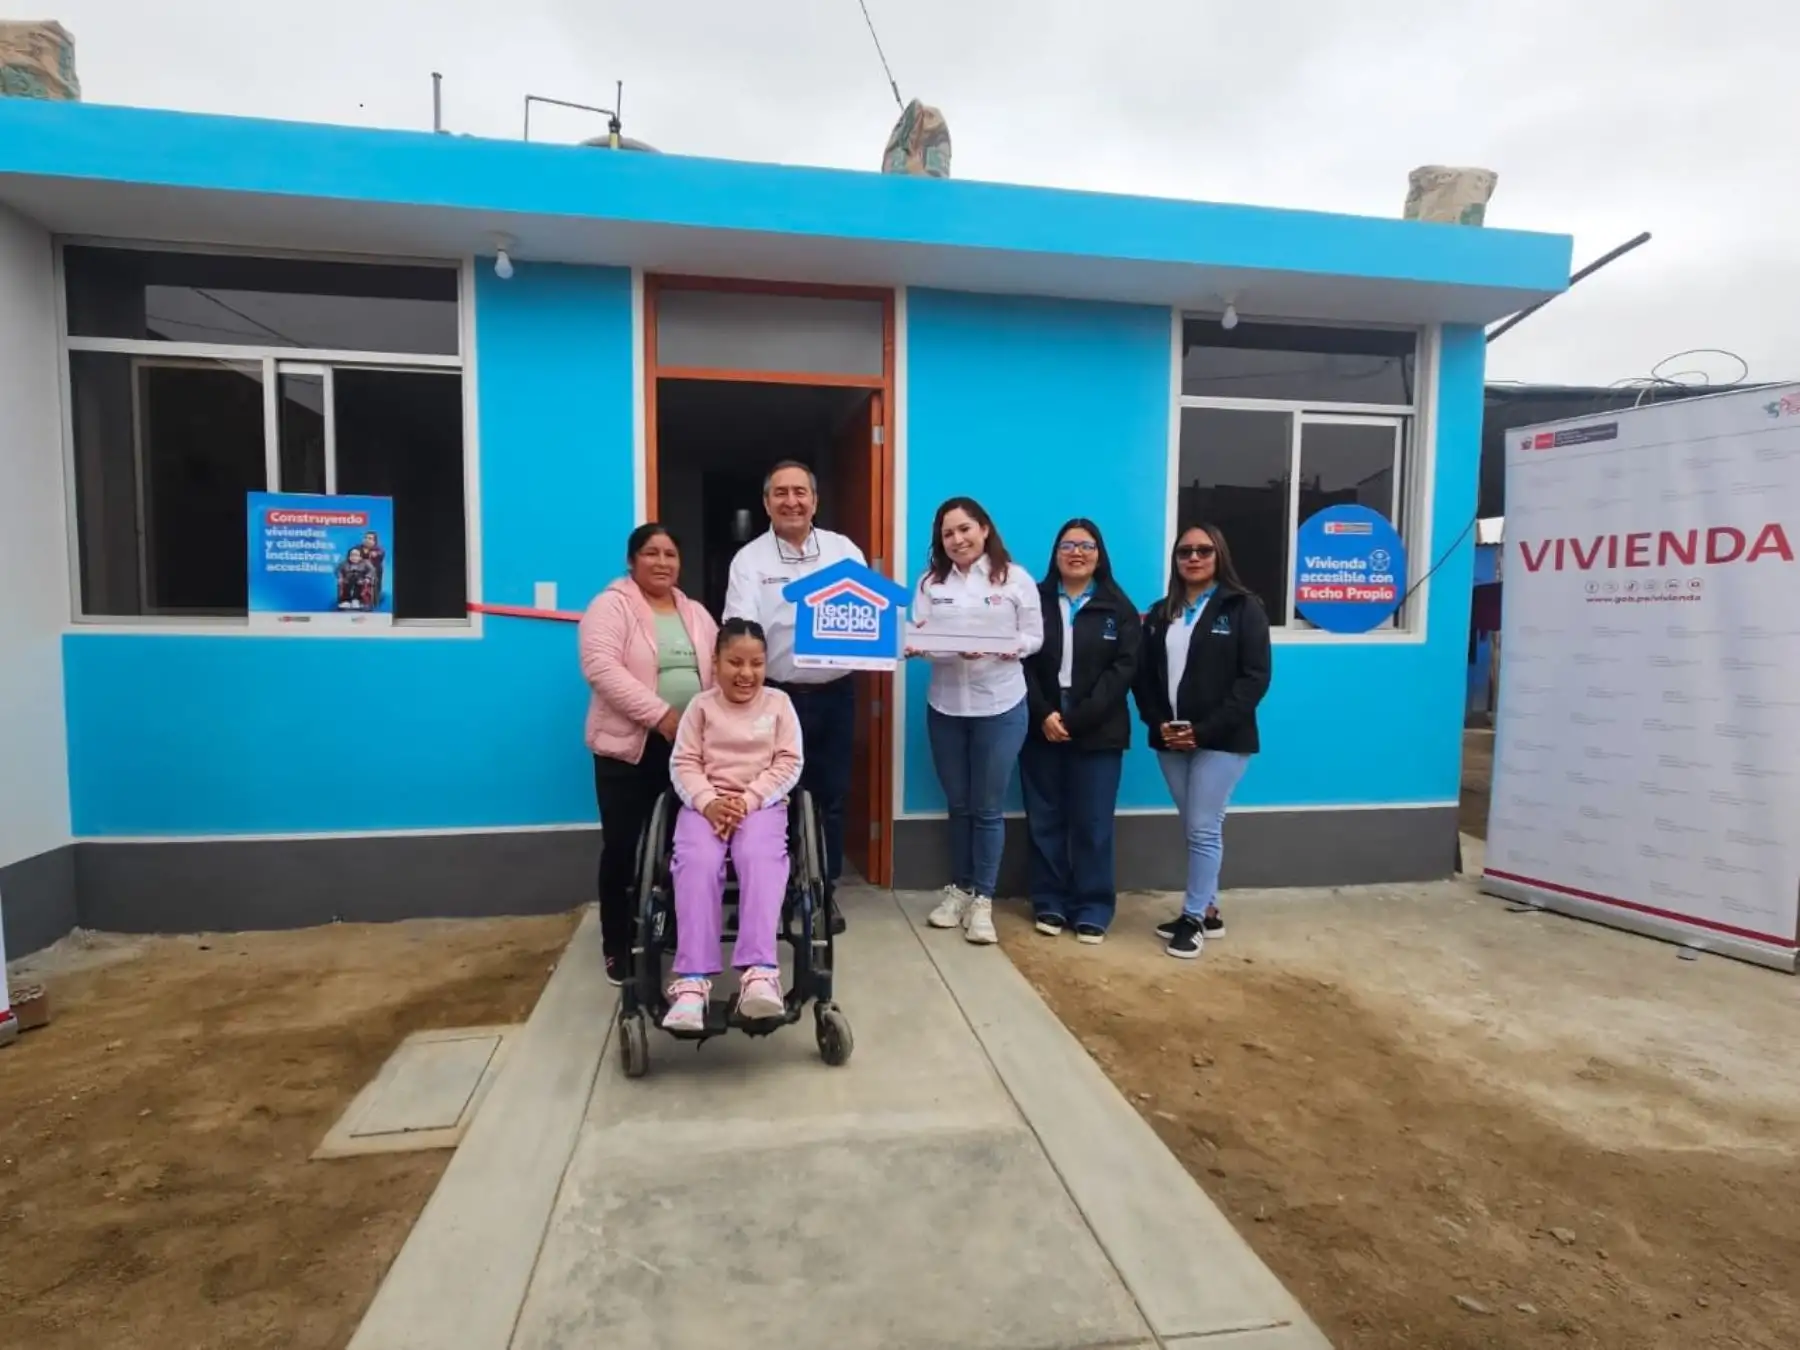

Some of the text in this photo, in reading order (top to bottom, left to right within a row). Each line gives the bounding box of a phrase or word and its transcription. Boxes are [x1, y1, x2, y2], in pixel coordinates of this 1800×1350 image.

[270, 511, 364, 526] Construyendo
[265, 526, 327, 538] viviendas
[265, 538, 336, 550] y ciudades
[1518, 523, 1795, 573] VIVIENDA
[265, 550, 330, 562] inclusivas
[1304, 556, 1367, 570] Vivienda
[1301, 570, 1394, 583] accesible con
[1302, 587, 1394, 603] Techo Propio
[819, 601, 873, 618] techo
[818, 616, 877, 632] propio
